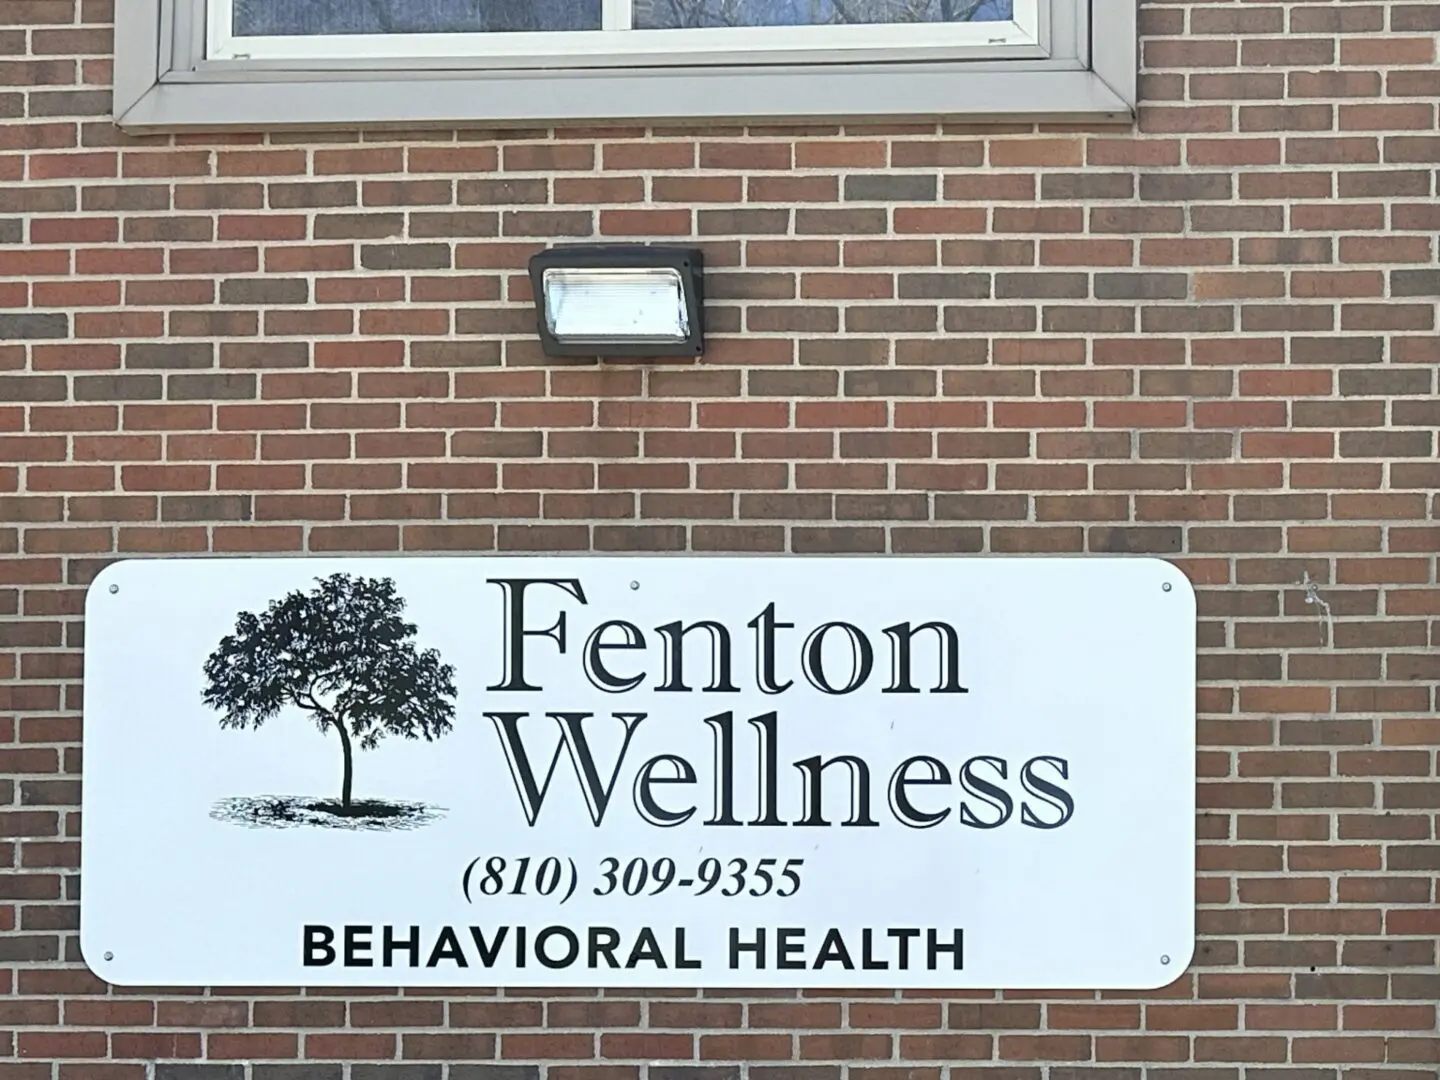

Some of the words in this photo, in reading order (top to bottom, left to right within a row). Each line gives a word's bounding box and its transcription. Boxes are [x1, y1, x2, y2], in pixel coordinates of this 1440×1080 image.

[486, 578, 969, 695] Fenton
[482, 710, 1075, 830] Wellness
[462, 856, 578, 905] (810)
[593, 857, 805, 898] 309-9355
[303, 925, 701, 970] BEHAVIORAL
[729, 928, 964, 971] HEALTH
